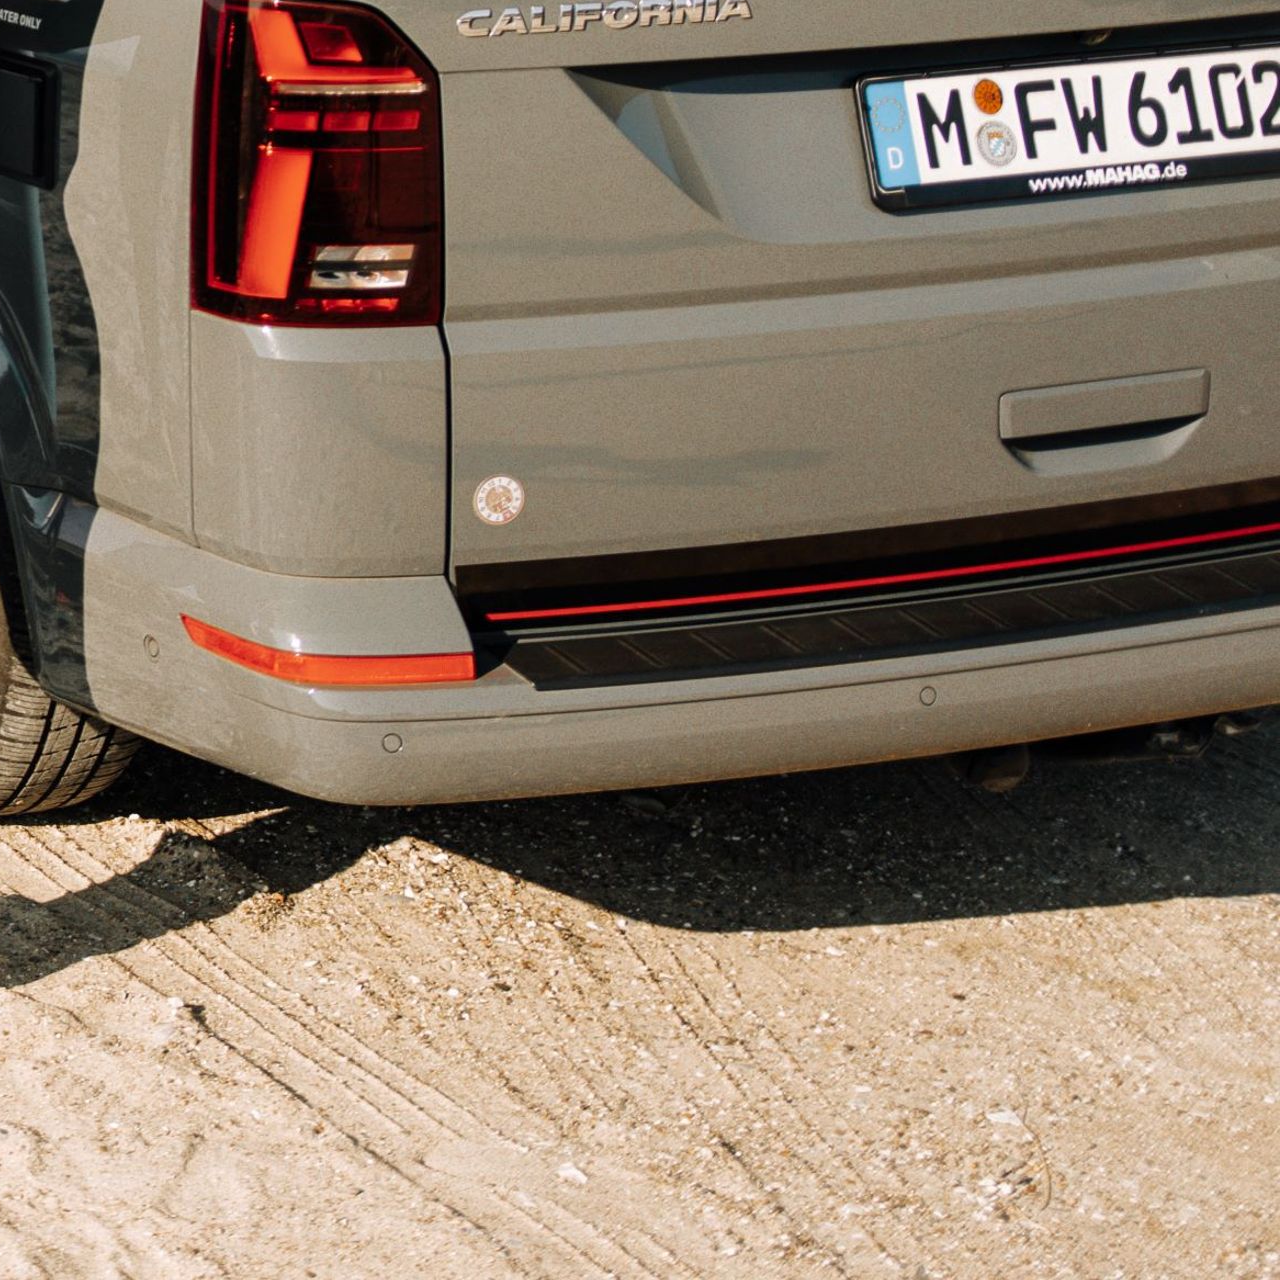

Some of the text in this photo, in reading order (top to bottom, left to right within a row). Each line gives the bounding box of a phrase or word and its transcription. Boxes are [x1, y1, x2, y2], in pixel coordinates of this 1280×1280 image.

[20, 14, 42, 30] ONLY
[916, 60, 1280, 169] M FW 6102
[887, 147, 905, 170] D
[1029, 161, 1187, 193] www.MAHAG.de
